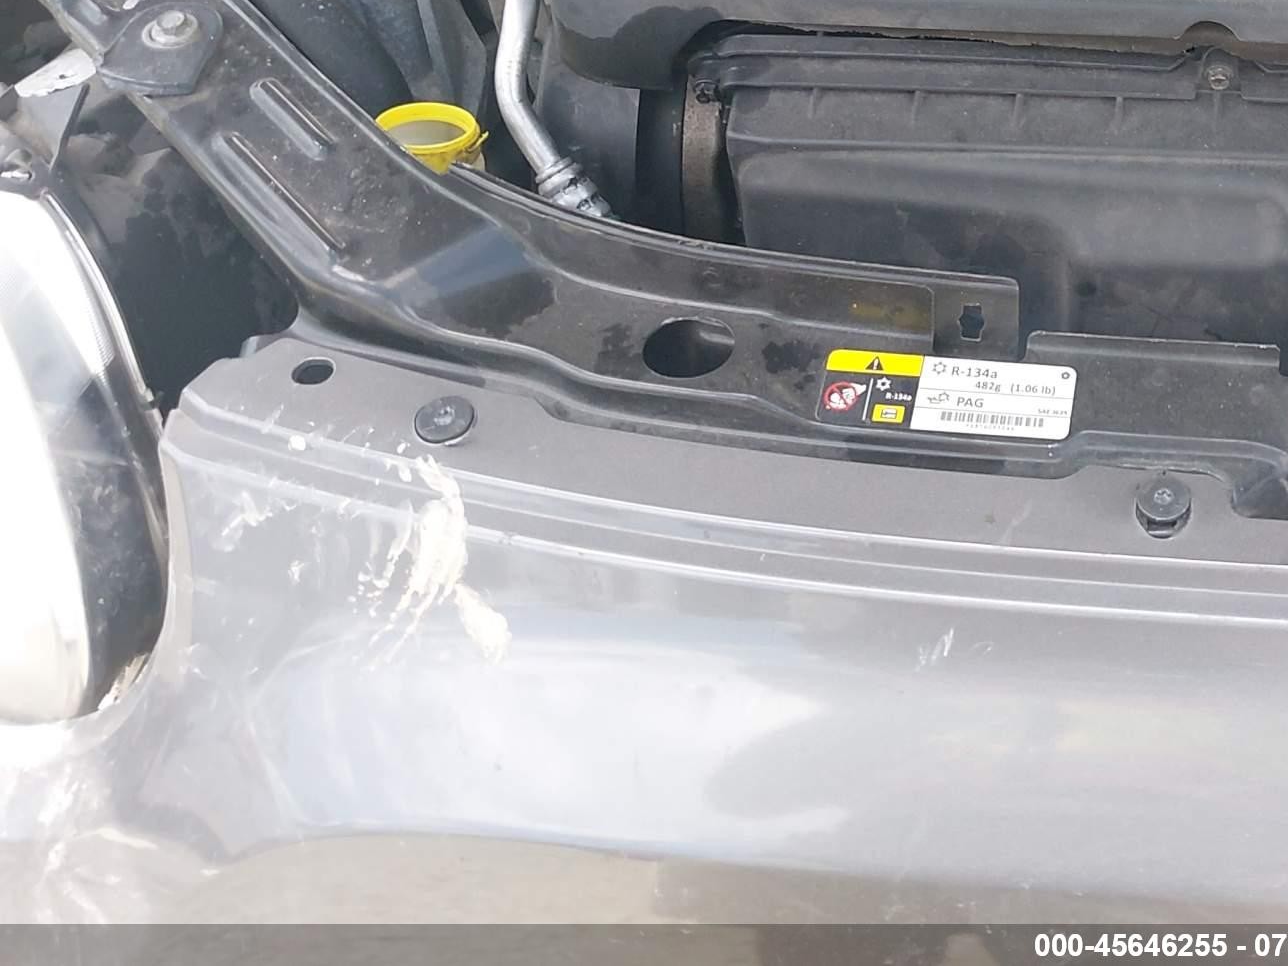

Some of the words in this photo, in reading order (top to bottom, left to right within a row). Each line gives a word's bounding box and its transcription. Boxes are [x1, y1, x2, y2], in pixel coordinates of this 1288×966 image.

[951, 366, 998, 379] R-134a
[1010, 383, 1038, 394] (1.06
[1041, 384, 1057, 395] lb)
[885, 391, 913, 402] R-134a
[956, 397, 985, 409] PAG
